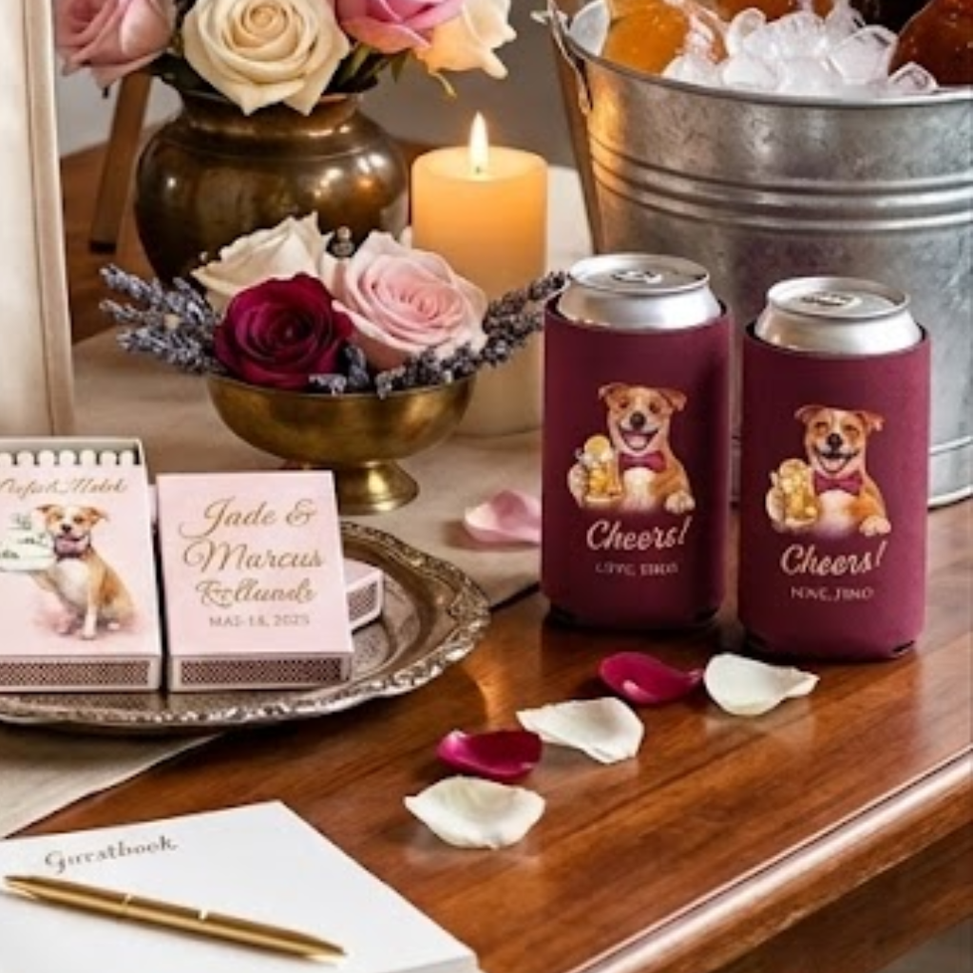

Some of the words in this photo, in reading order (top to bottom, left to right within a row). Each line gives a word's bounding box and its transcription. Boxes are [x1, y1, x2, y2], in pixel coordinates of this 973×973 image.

[178, 496, 277, 540] Jade
[285, 498, 318, 526] &
[586, 516, 692, 551] Cheers!
[182, 538, 326, 573] Marcus
[780, 540, 887, 576] Cheers!
